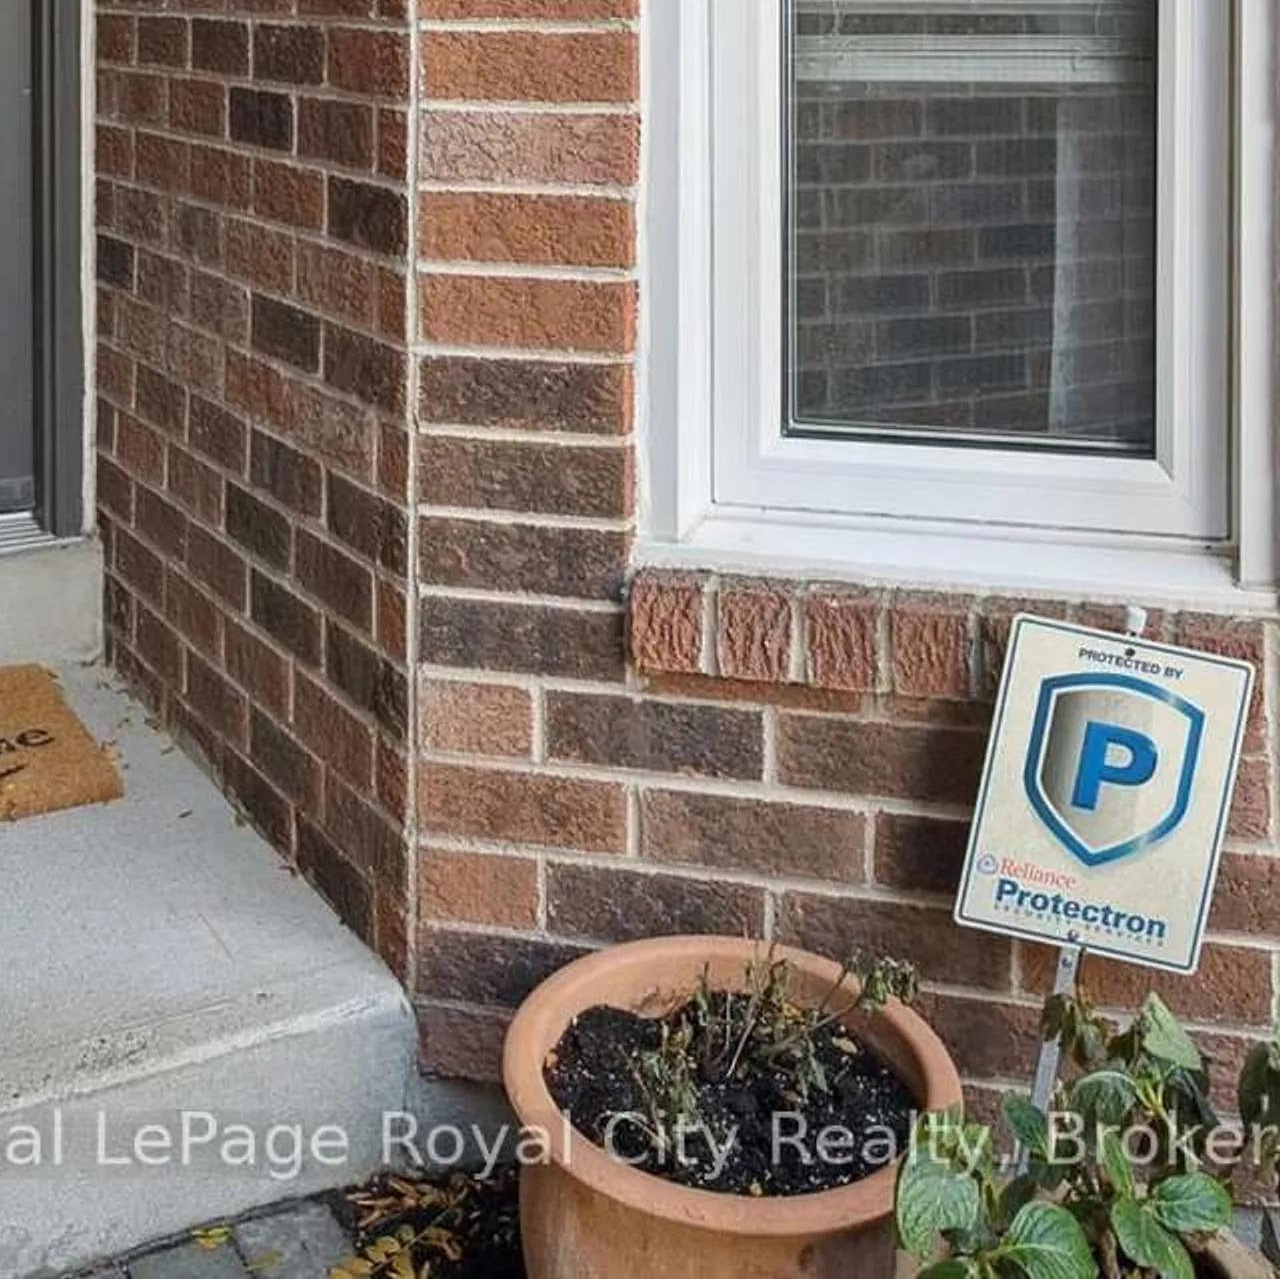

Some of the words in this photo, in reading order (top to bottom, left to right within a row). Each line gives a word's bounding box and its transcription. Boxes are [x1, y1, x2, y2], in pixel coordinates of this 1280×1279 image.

[1078, 647, 1161, 675] PROTECTED
[1163, 666, 1185, 680] BY
[1070, 720, 1158, 812] P
[999, 856, 1078, 890] Reliance
[995, 878, 1167, 938] Protectron
